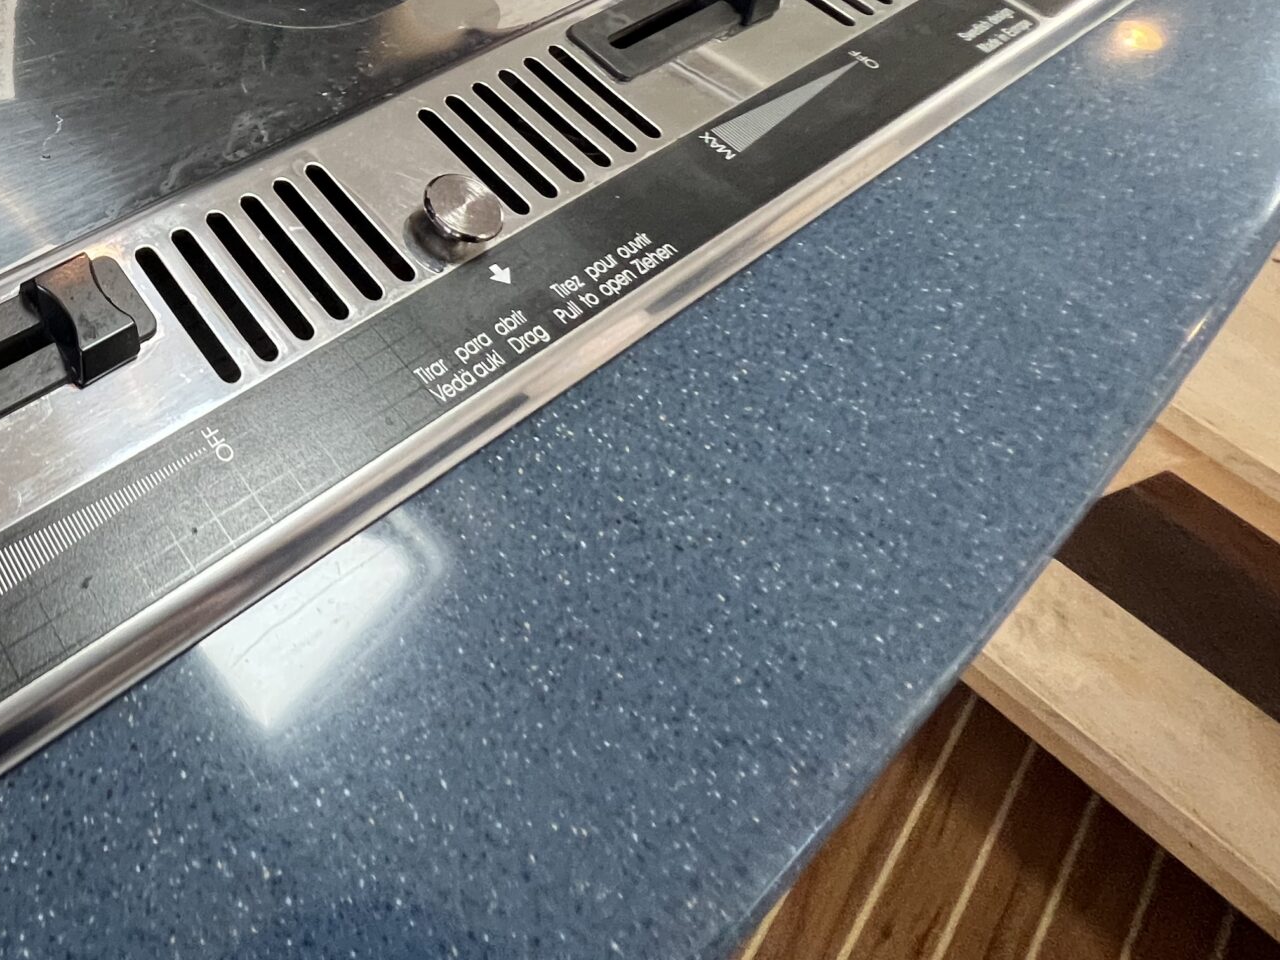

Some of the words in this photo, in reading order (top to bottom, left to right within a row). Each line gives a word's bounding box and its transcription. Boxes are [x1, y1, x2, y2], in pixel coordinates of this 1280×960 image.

[848, 51, 879, 69] OFF
[976, 38, 1004, 53] Made
[699, 132, 736, 160] MAX
[413, 359, 448, 384] Tirar
[454, 332, 493, 364] para
[495, 310, 527, 335] abrir
[549, 275, 586, 298] Tirez
[584, 254, 618, 281] pour
[617, 232, 652, 258] ouvrir
[429, 369, 477, 402] Vedä
[473, 350, 506, 378] auki
[507, 325, 550, 354] Drag
[553, 300, 583, 324] Pull
[578, 293, 599, 308] to
[599, 269, 638, 294] open
[630, 244, 678, 274] Ziehen
[201, 427, 234, 462] OFF
